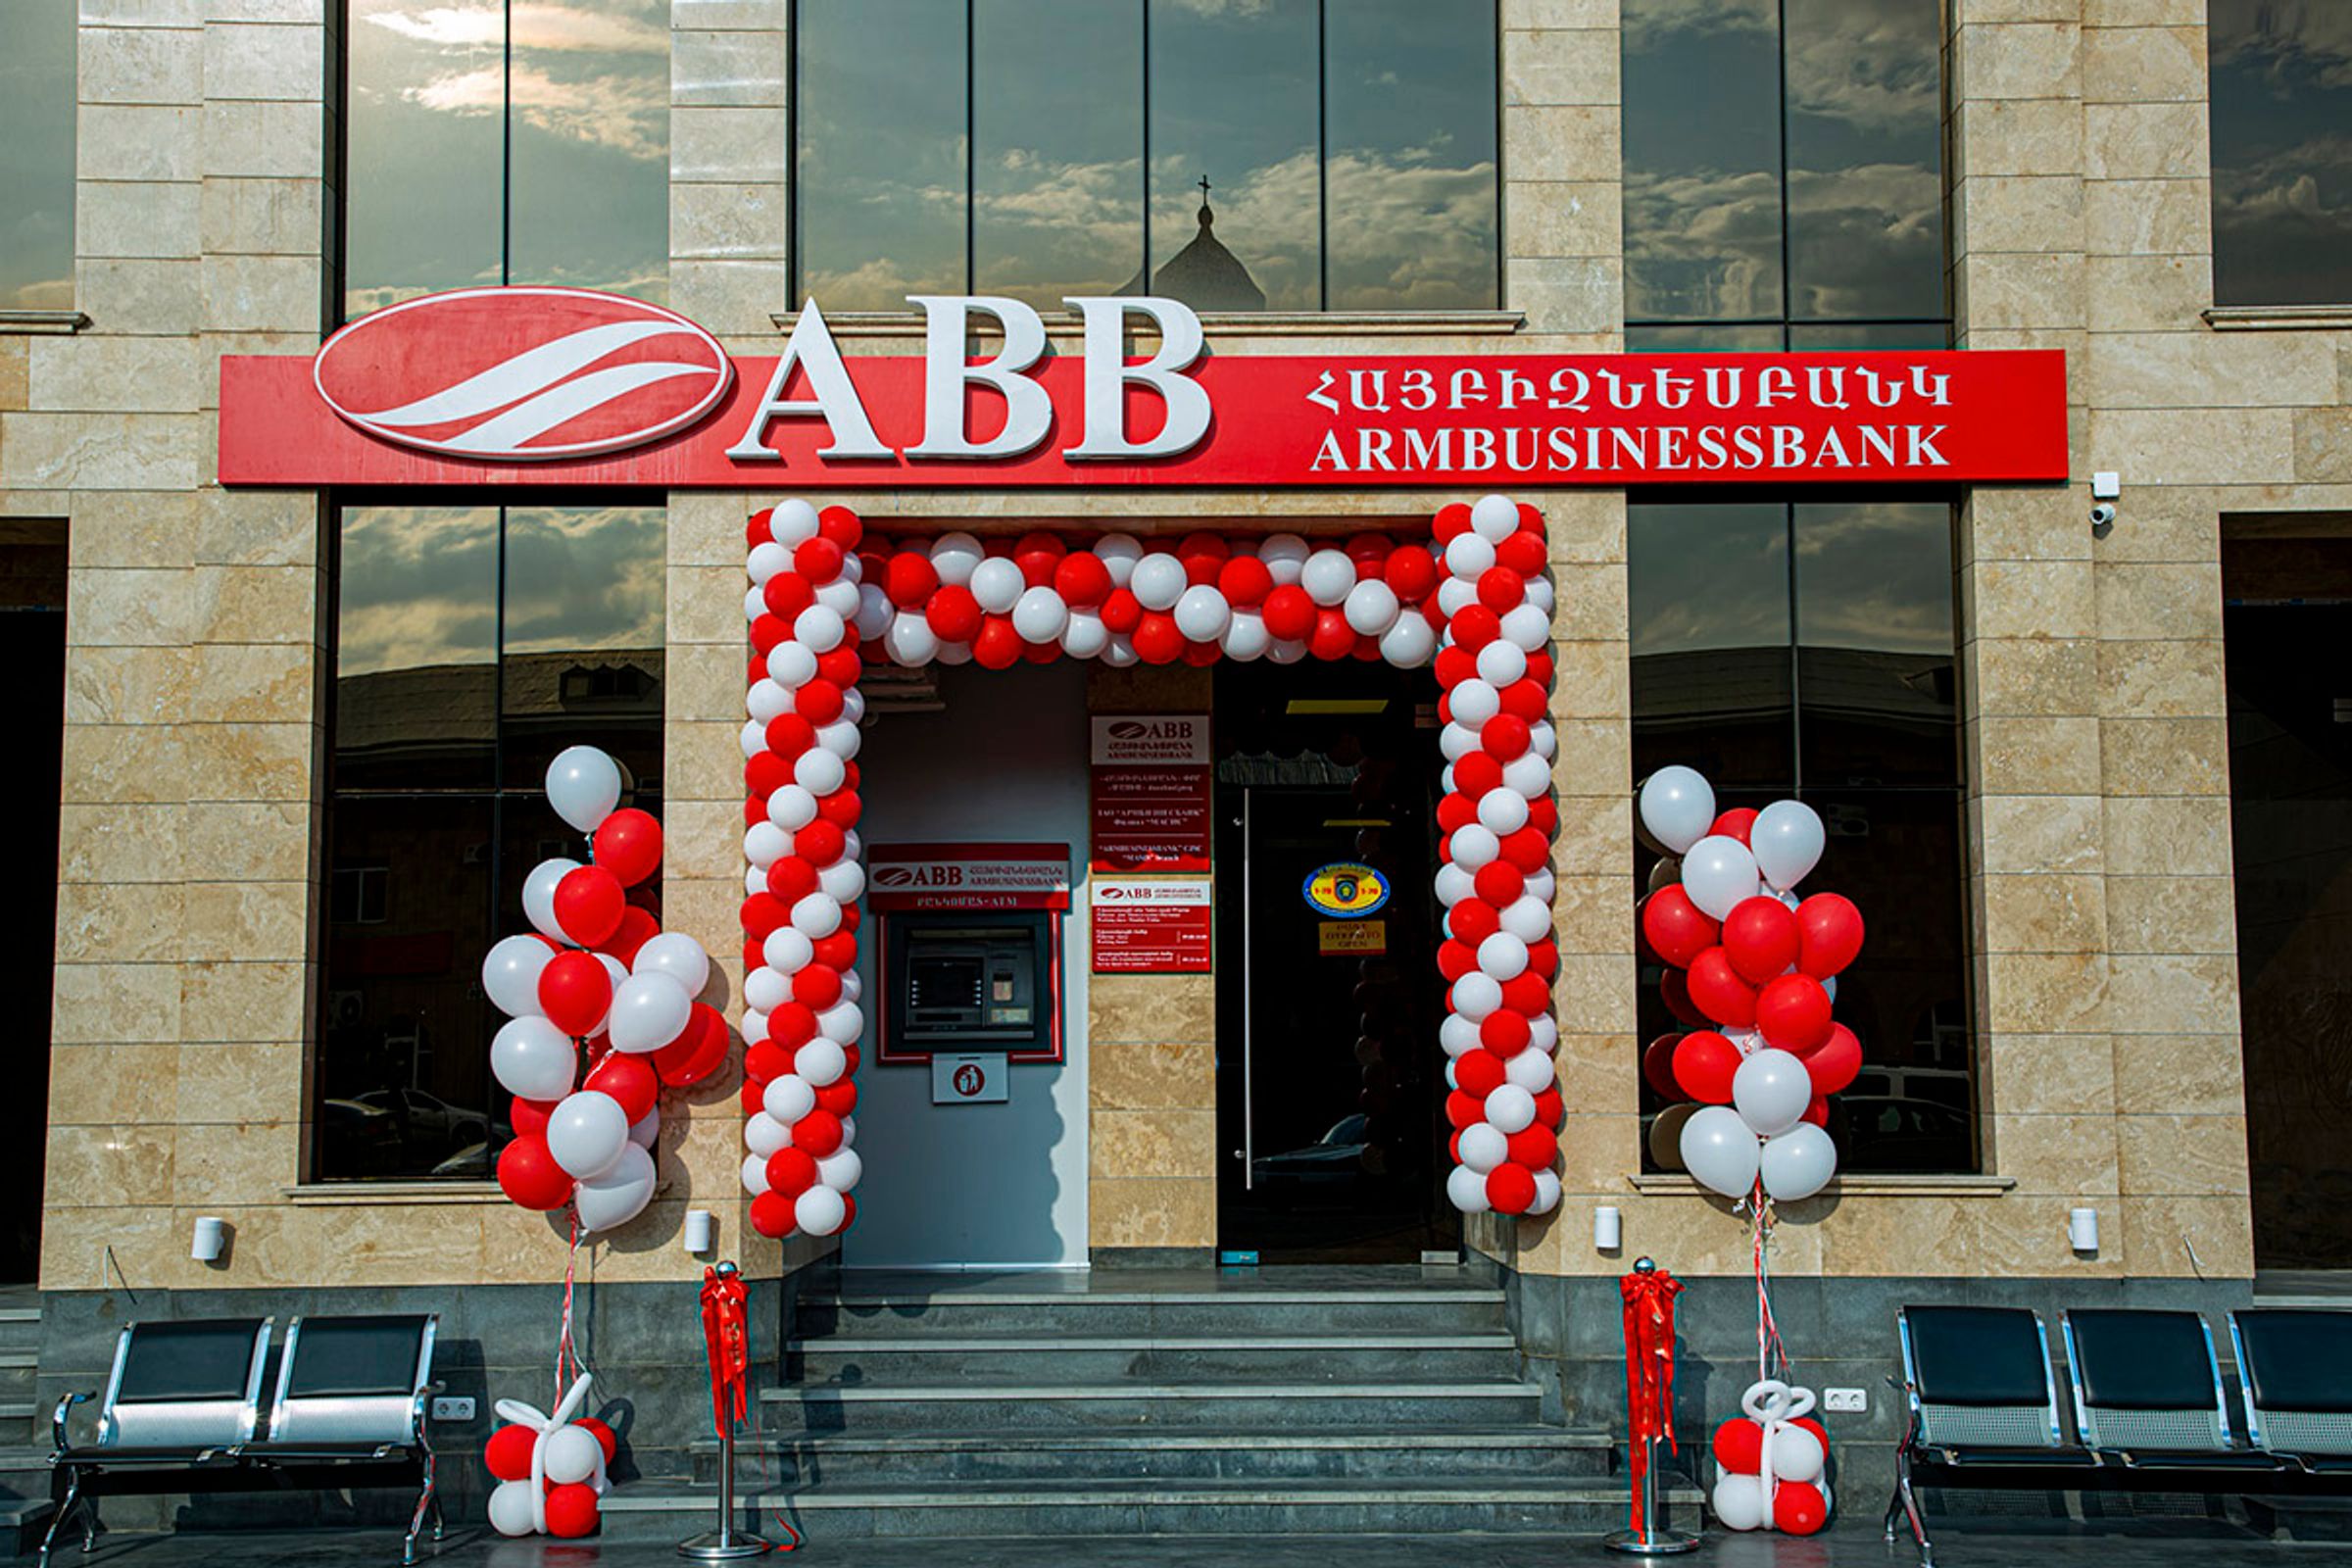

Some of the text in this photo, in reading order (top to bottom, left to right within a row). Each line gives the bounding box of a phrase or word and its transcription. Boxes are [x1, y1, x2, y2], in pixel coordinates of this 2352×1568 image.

[725, 296, 1211, 461] ABB
[1306, 365, 1952, 416] ՀԱՅԲԻԶՆԵՍԲԱՆԿ
[1309, 424, 1950, 472] ARMBUSINESSBANK
[1148, 721, 1193, 738] ABB
[912, 866, 963, 886] ABB
[1124, 887, 1152, 899] ABB
